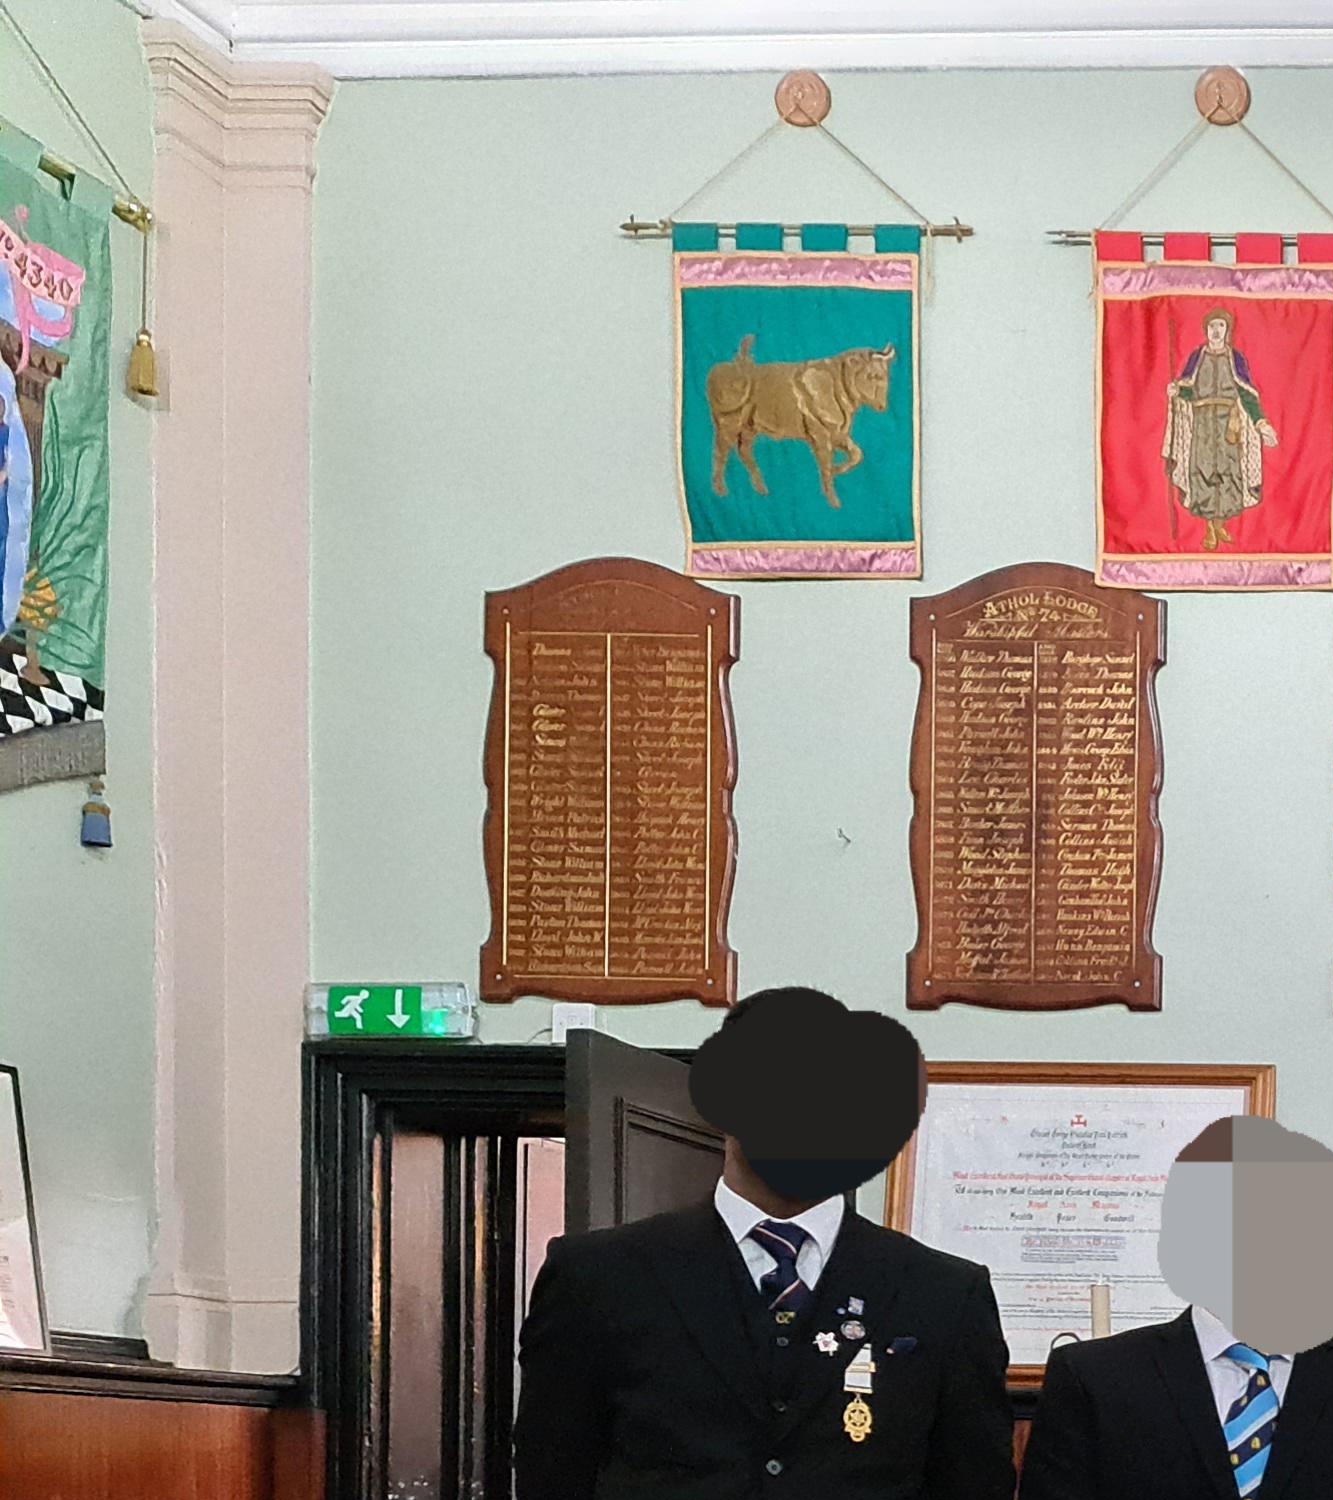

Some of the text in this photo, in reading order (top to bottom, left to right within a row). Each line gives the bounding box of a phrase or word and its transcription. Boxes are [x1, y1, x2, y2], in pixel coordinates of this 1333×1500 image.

[983, 591, 1098, 619] ATHOL LODGE
[1039, 608, 1061, 622] 74
